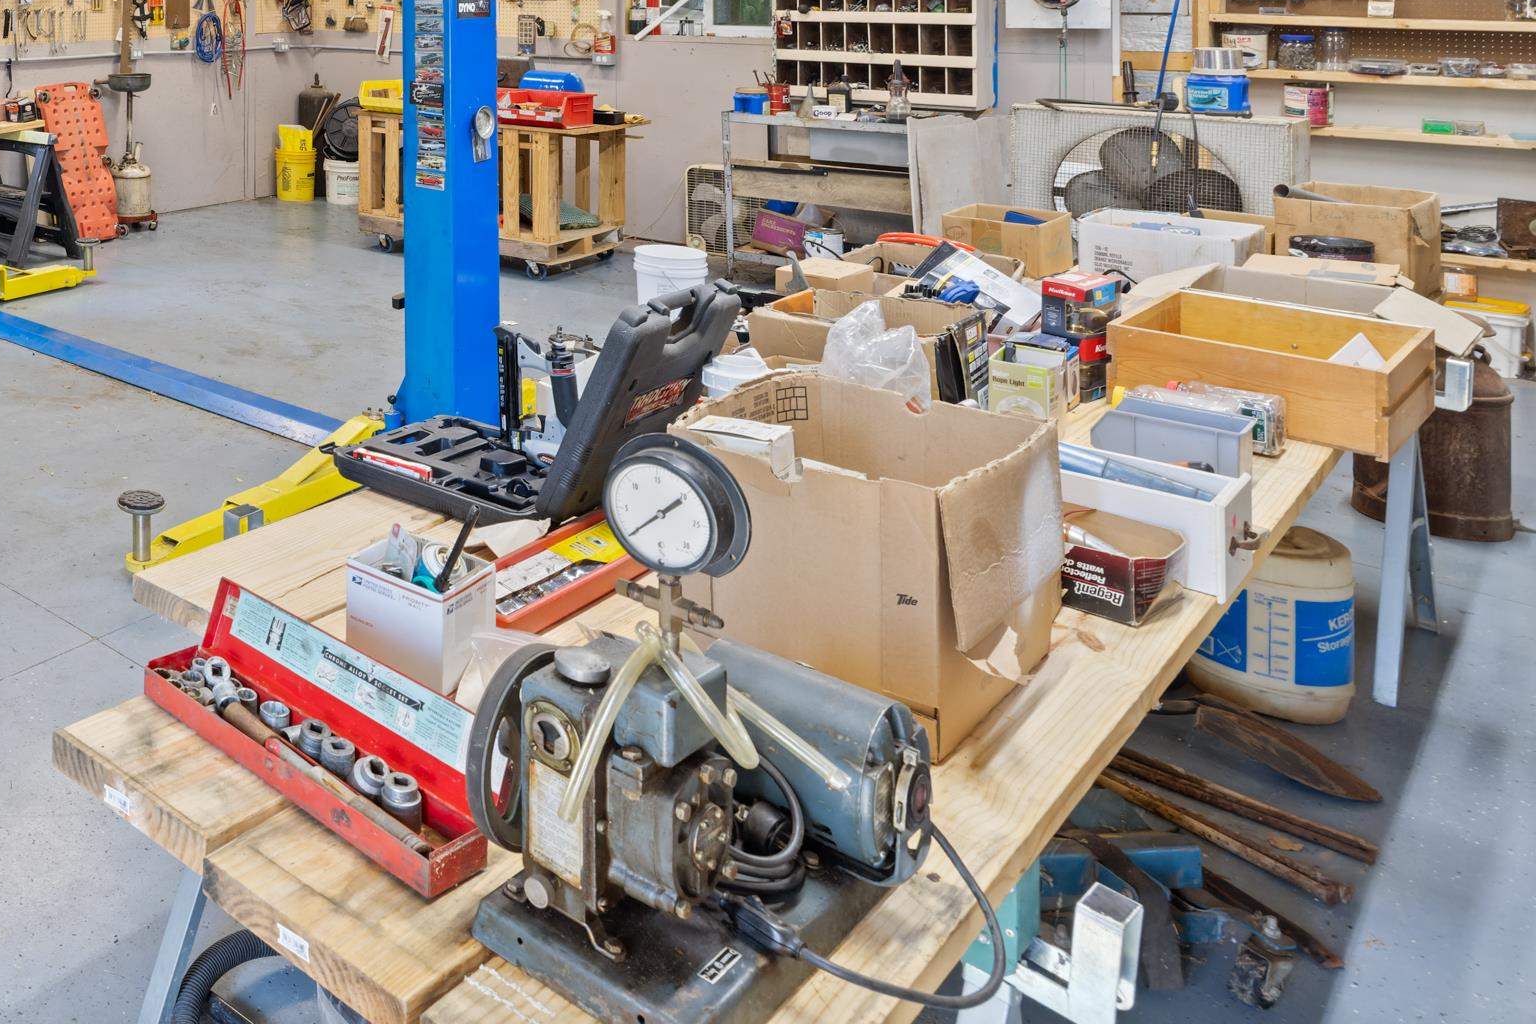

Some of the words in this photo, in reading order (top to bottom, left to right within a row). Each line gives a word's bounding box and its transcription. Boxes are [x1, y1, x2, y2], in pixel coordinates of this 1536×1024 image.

[1048, 287, 1076, 298] Kwikset
[992, 376, 1008, 385] Rope
[1009, 379, 1025, 387] Light
[632, 483, 639, 491] 10
[1076, 562, 1105, 575] watts
[896, 593, 919, 607] Tide
[1075, 581, 1125, 607] Regent
[324, 651, 348, 670] CHROME
[348, 665, 367, 679] ALLOY
[397, 693, 409, 703] SET
